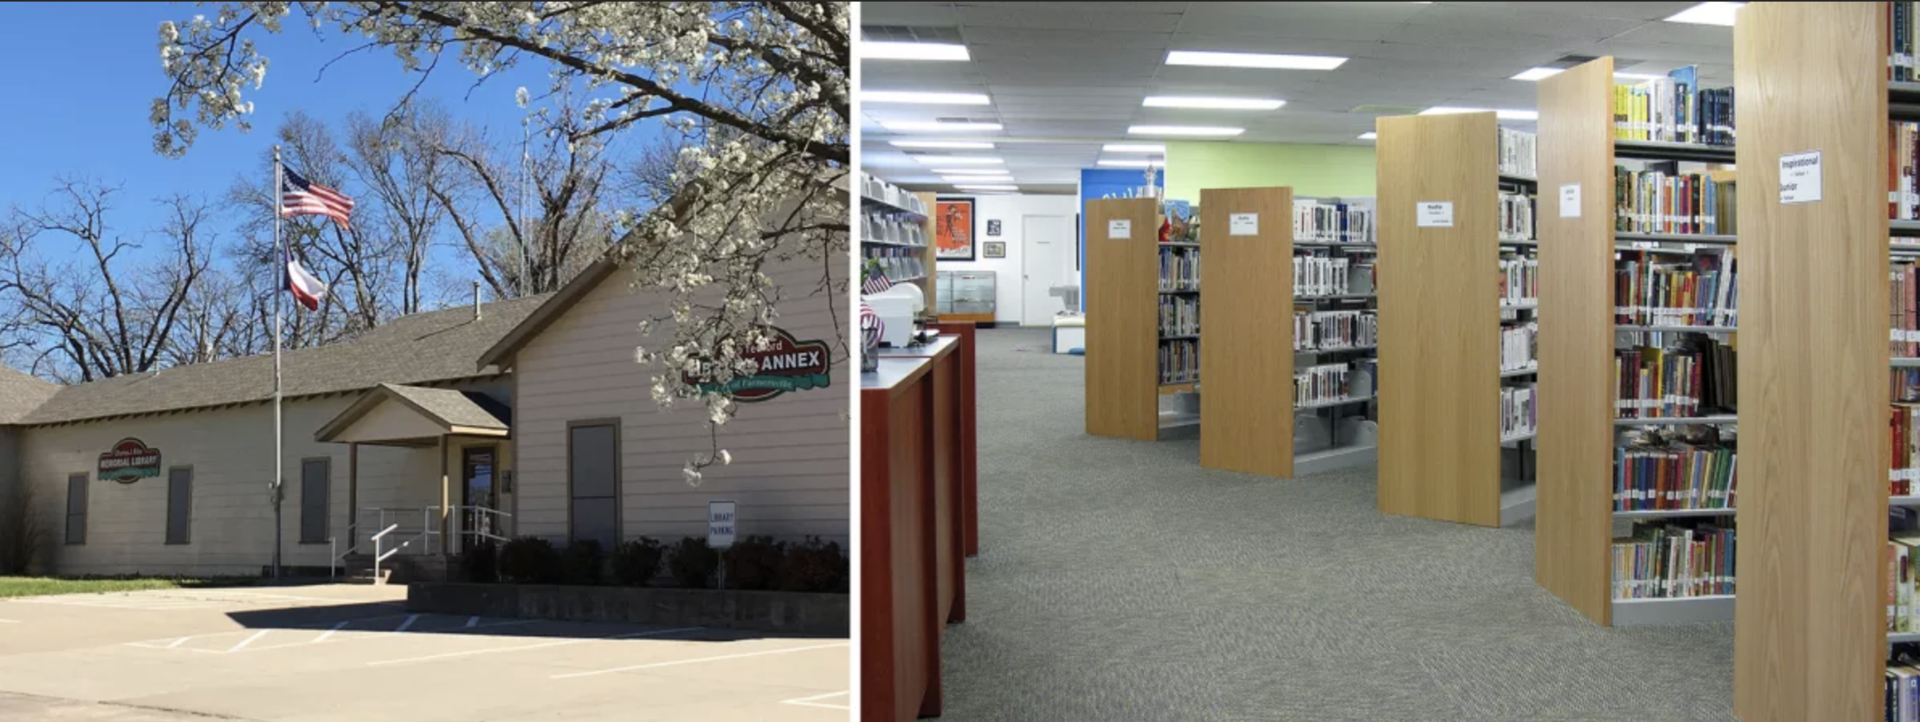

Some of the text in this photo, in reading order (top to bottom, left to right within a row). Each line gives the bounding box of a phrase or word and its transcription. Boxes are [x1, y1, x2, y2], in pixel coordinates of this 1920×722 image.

[761, 351, 821, 371] ANNEX
[101, 455, 157, 468] MEMORIAL LIBRARY
[710, 512, 734, 523] LIBRARY
[710, 526, 734, 536] PARKING
